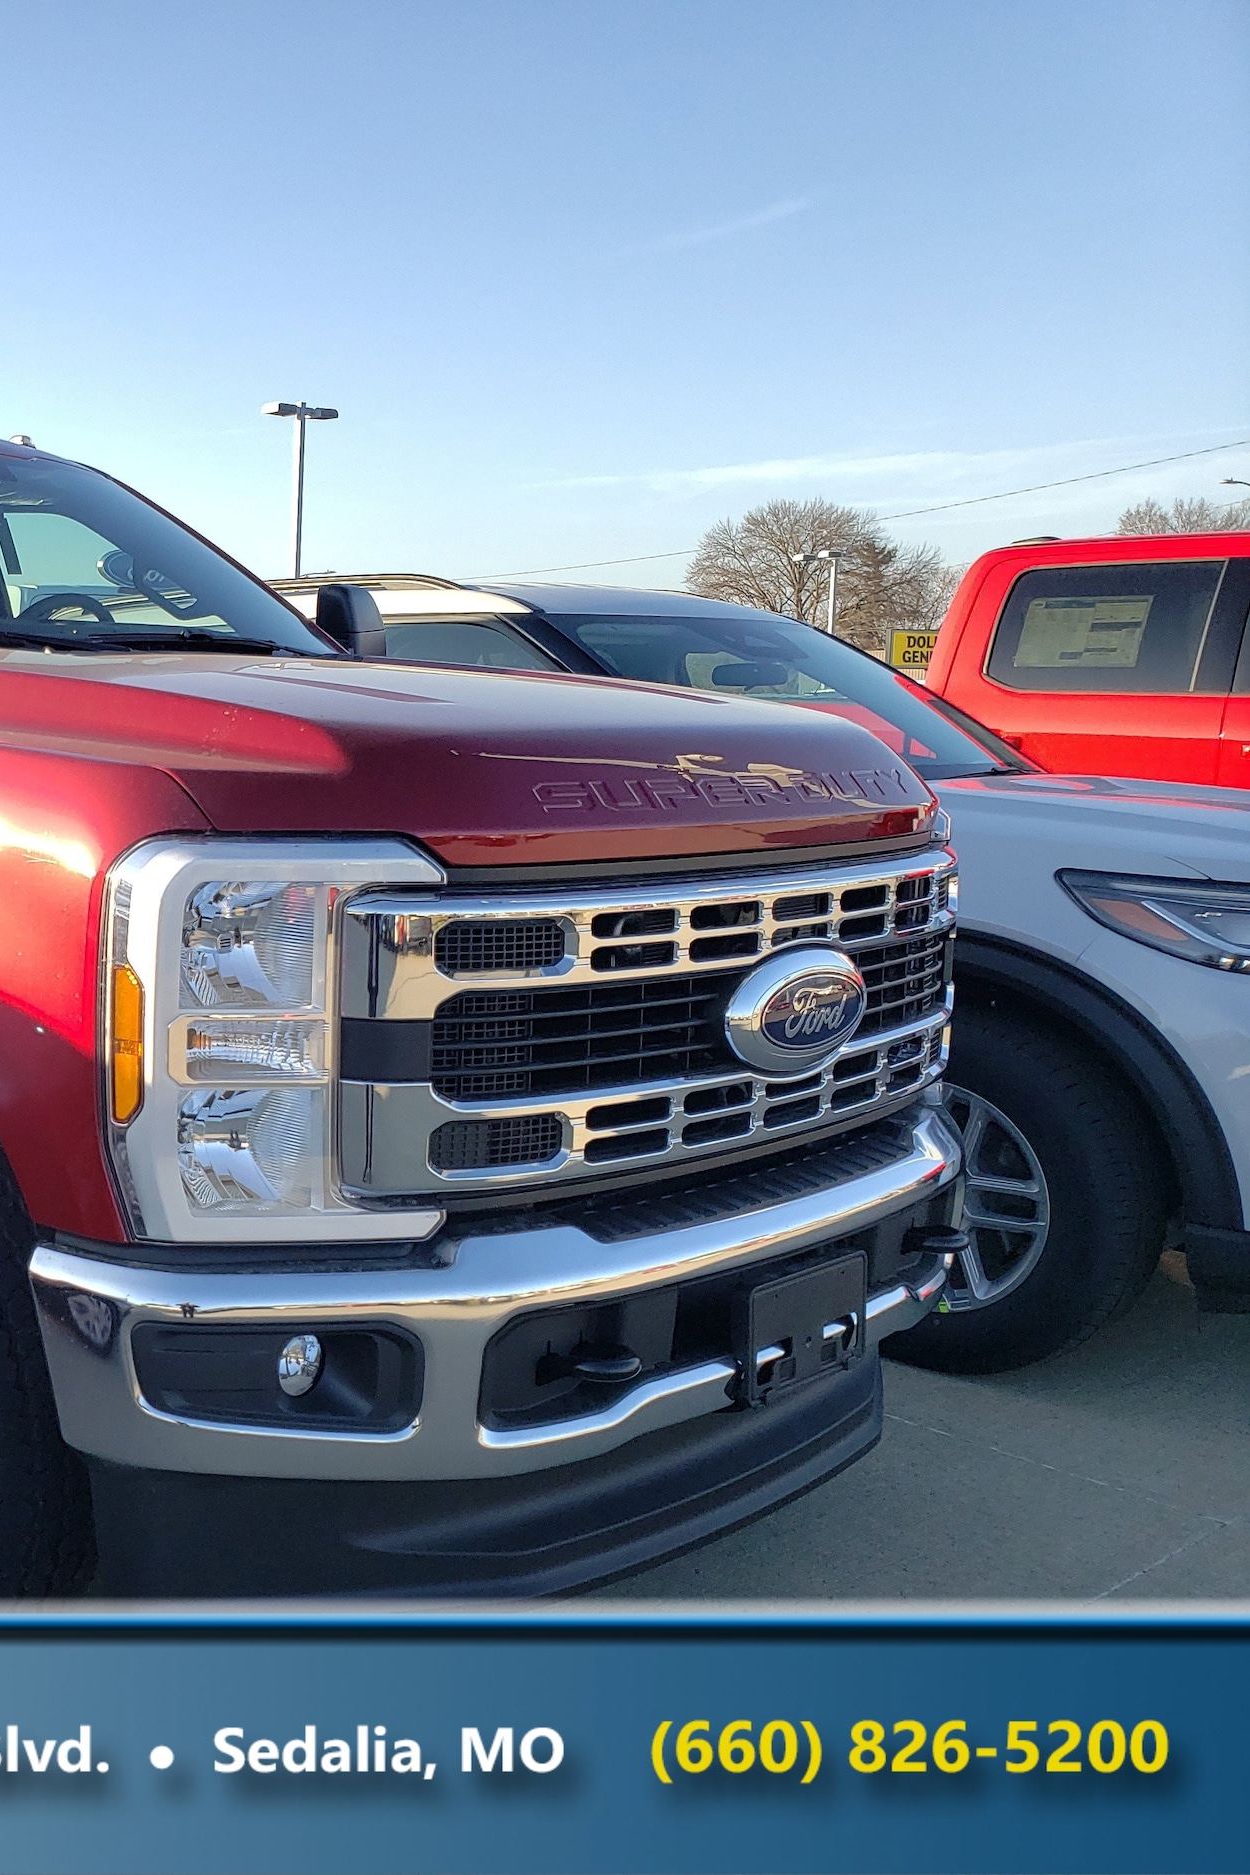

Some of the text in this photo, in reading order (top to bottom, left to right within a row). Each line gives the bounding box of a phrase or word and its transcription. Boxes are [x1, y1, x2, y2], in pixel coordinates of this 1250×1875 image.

[902, 650, 933, 663] GEN
[532, 768, 908, 812] SUPER DUTY
[784, 984, 848, 1039] Ford
